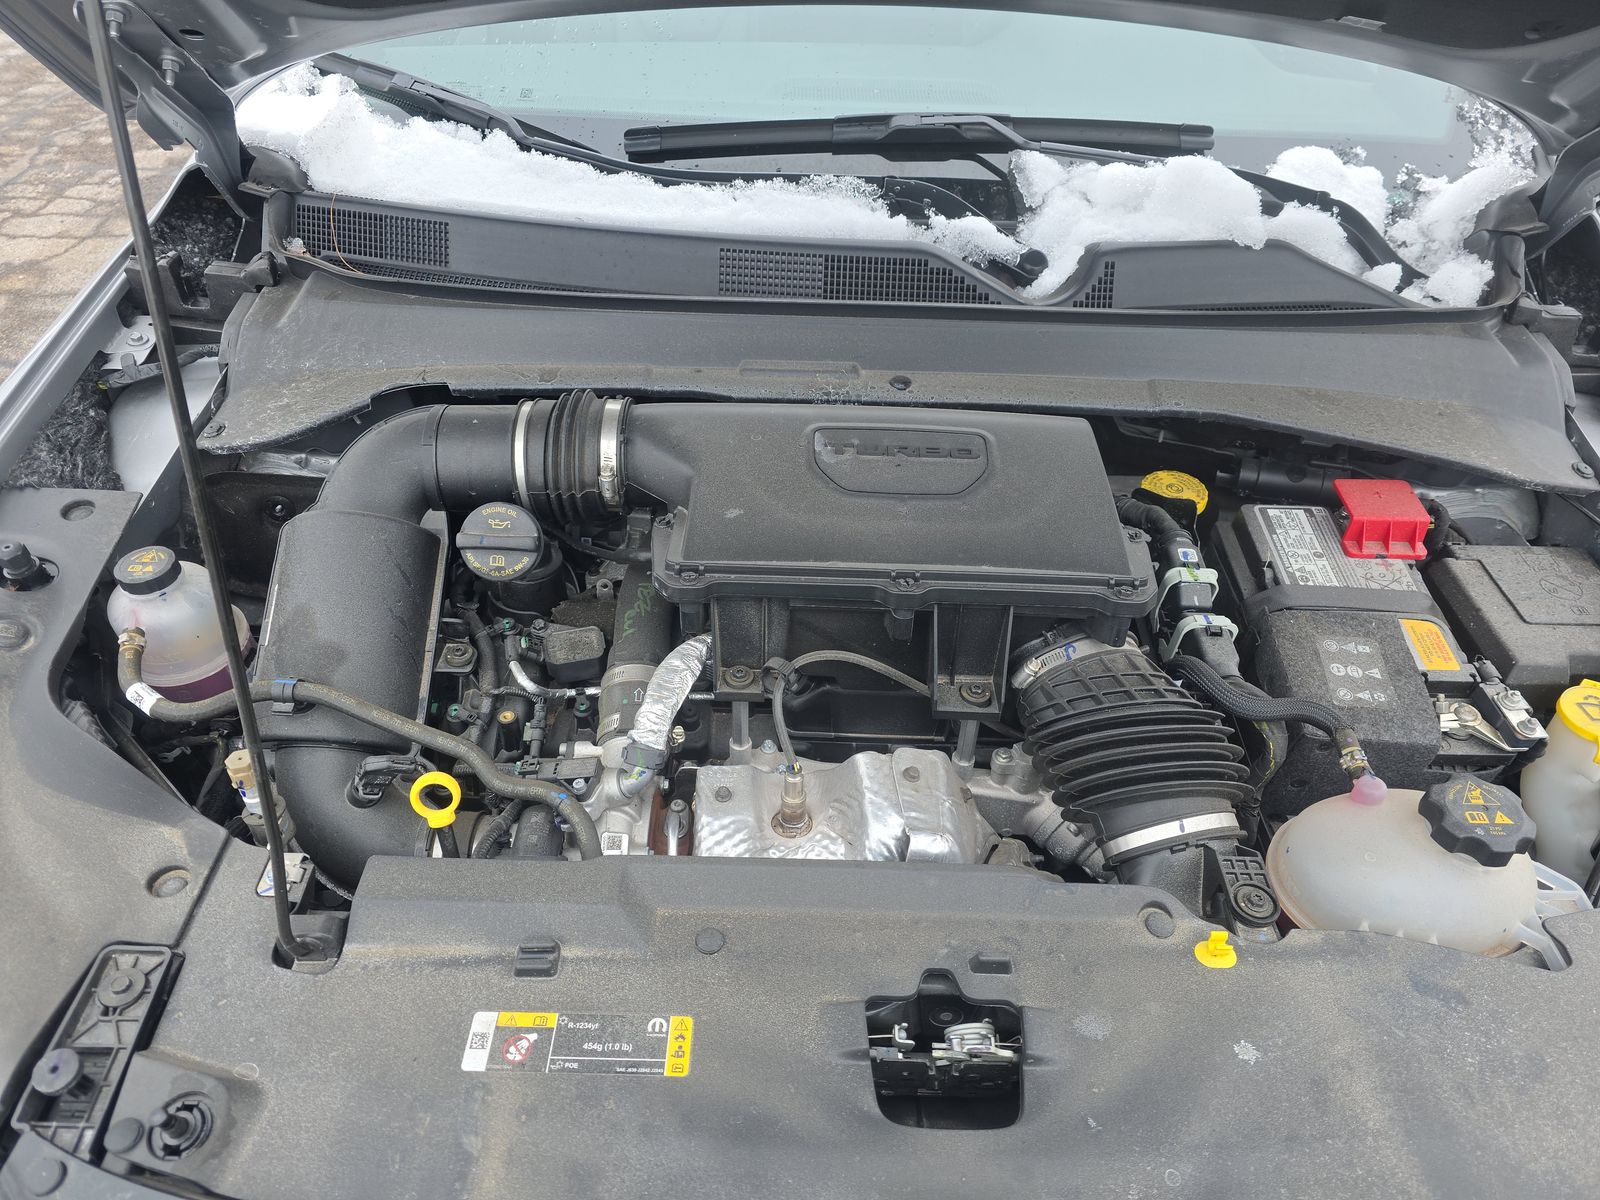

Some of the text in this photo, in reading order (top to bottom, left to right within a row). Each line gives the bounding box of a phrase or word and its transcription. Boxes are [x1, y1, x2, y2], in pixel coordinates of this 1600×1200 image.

[823, 442, 981, 460] TURBO
[482, 506, 518, 518] ENGINE OIL
[568, 1022, 598, 1030] R-1234yf
[582, 1043, 633, 1052] 454g (1.0 lb)
